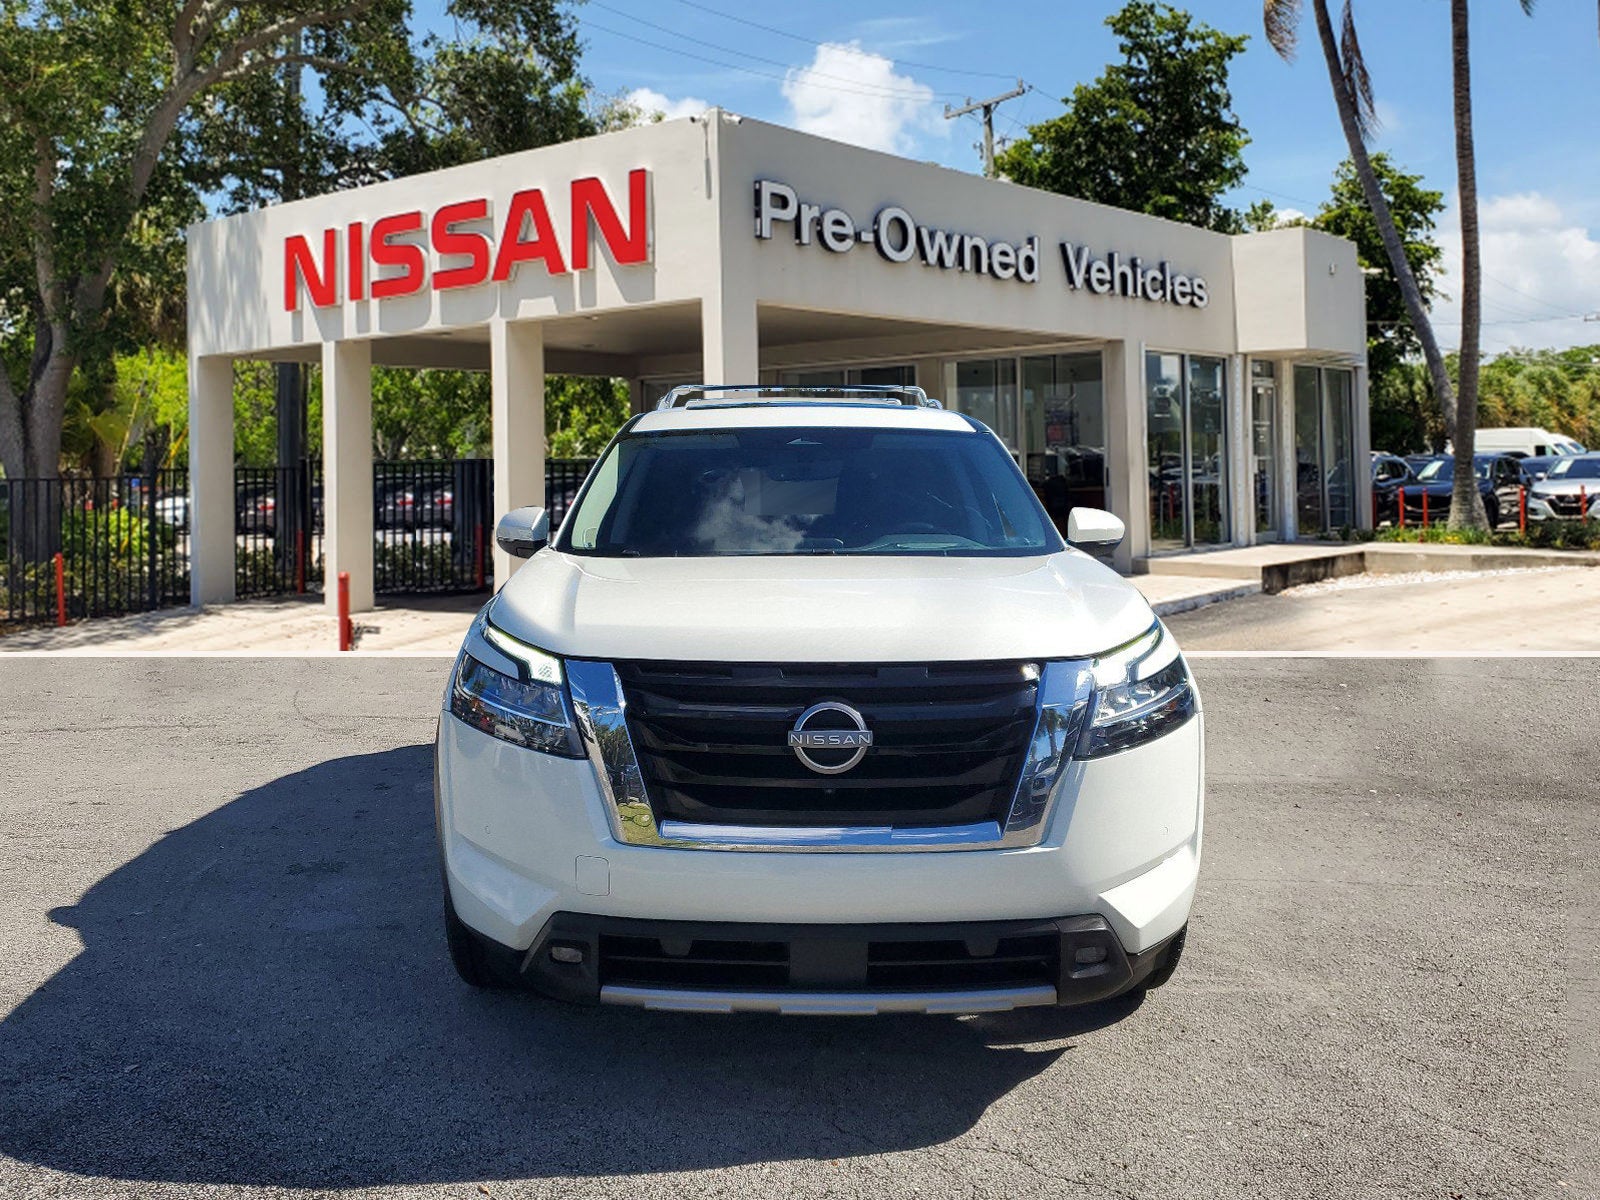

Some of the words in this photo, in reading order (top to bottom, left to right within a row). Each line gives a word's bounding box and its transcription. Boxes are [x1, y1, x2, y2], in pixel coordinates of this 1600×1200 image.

[284, 168, 648, 312] NISSAN
[755, 179, 1041, 283] Pre-Owned
[1060, 240, 1209, 308] Vehicles
[789, 734, 871, 745] NISSAN
